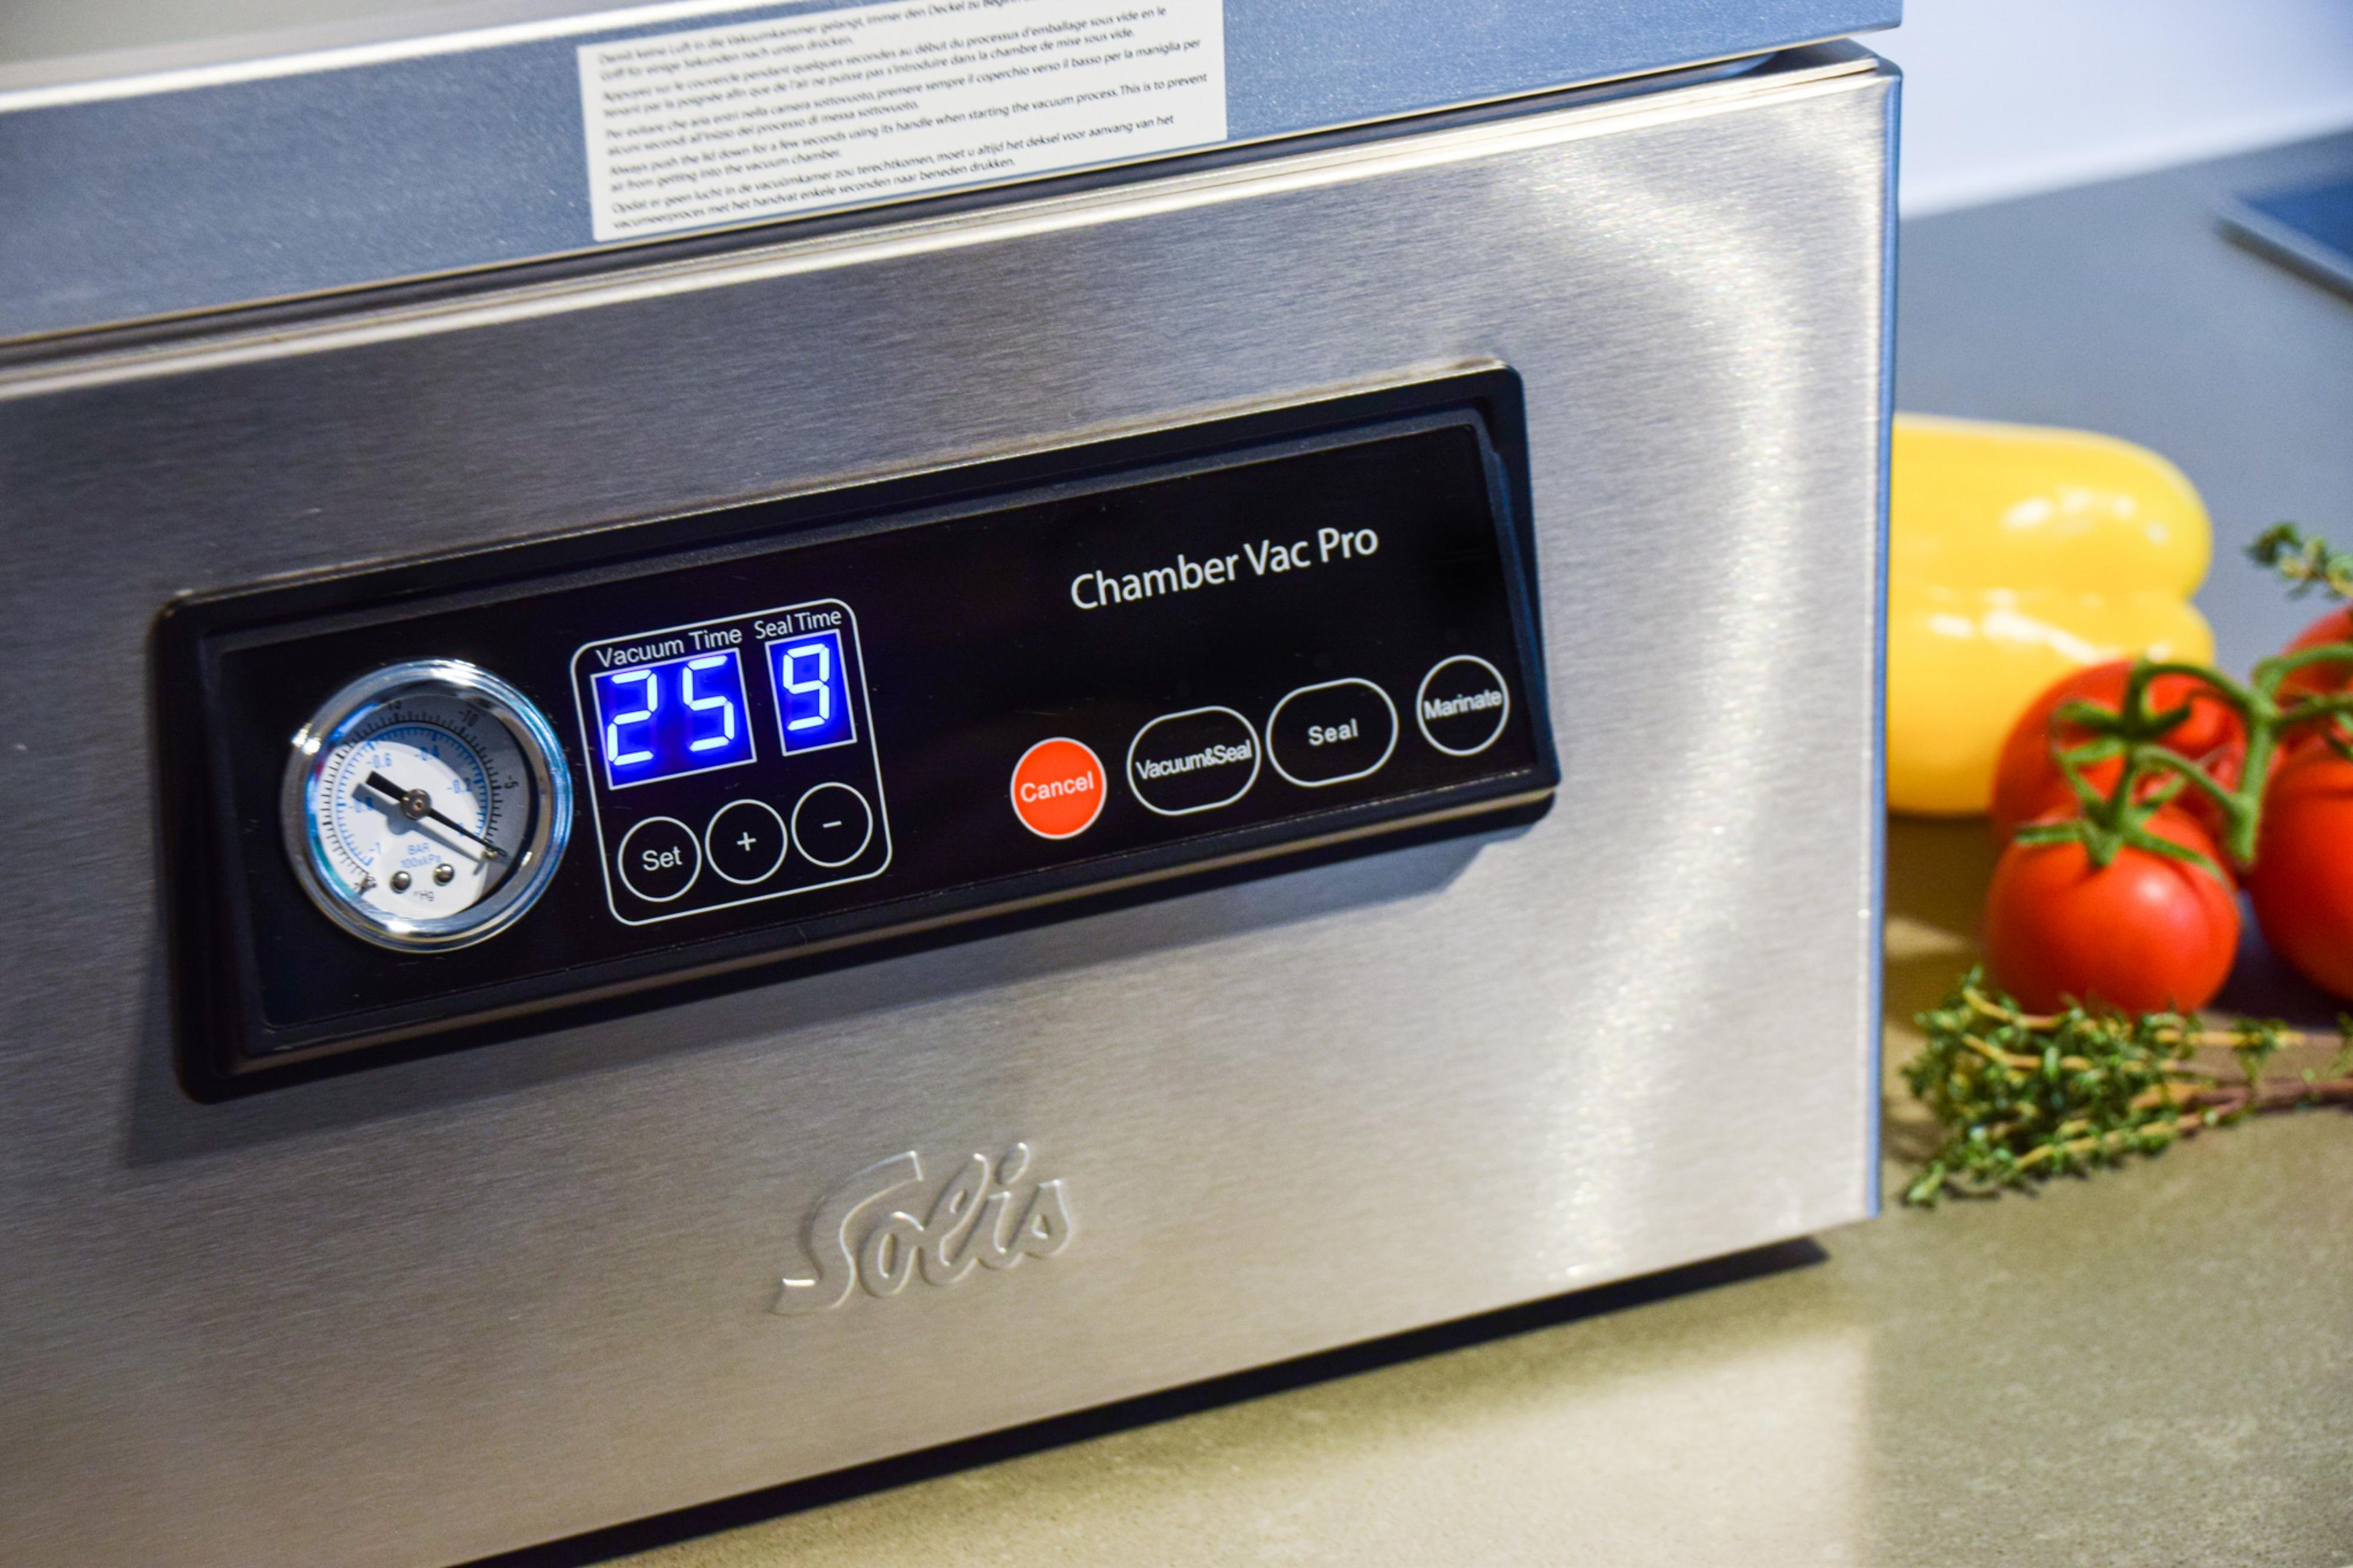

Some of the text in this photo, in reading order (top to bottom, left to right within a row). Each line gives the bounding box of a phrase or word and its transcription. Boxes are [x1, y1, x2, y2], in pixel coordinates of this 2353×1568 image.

[1182, 39, 1201, 52] per
[1070, 526, 1379, 610] Chamber Vac Pro
[754, 609, 842, 640] Seal Time
[595, 628, 743, 668] Vacuum Time
[782, 642, 830, 731] 9
[606, 654, 735, 766] 25
[1424, 688, 1504, 721] Marinate
[1308, 719, 1359, 746] Seal
[1135, 739, 1252, 780] Vacuum&Seal
[1019, 772, 1094, 803] Cancel
[407, 842, 429, 855] BAR
[642, 846, 682, 871] Set
[771, 1142, 1074, 1316] Solis
